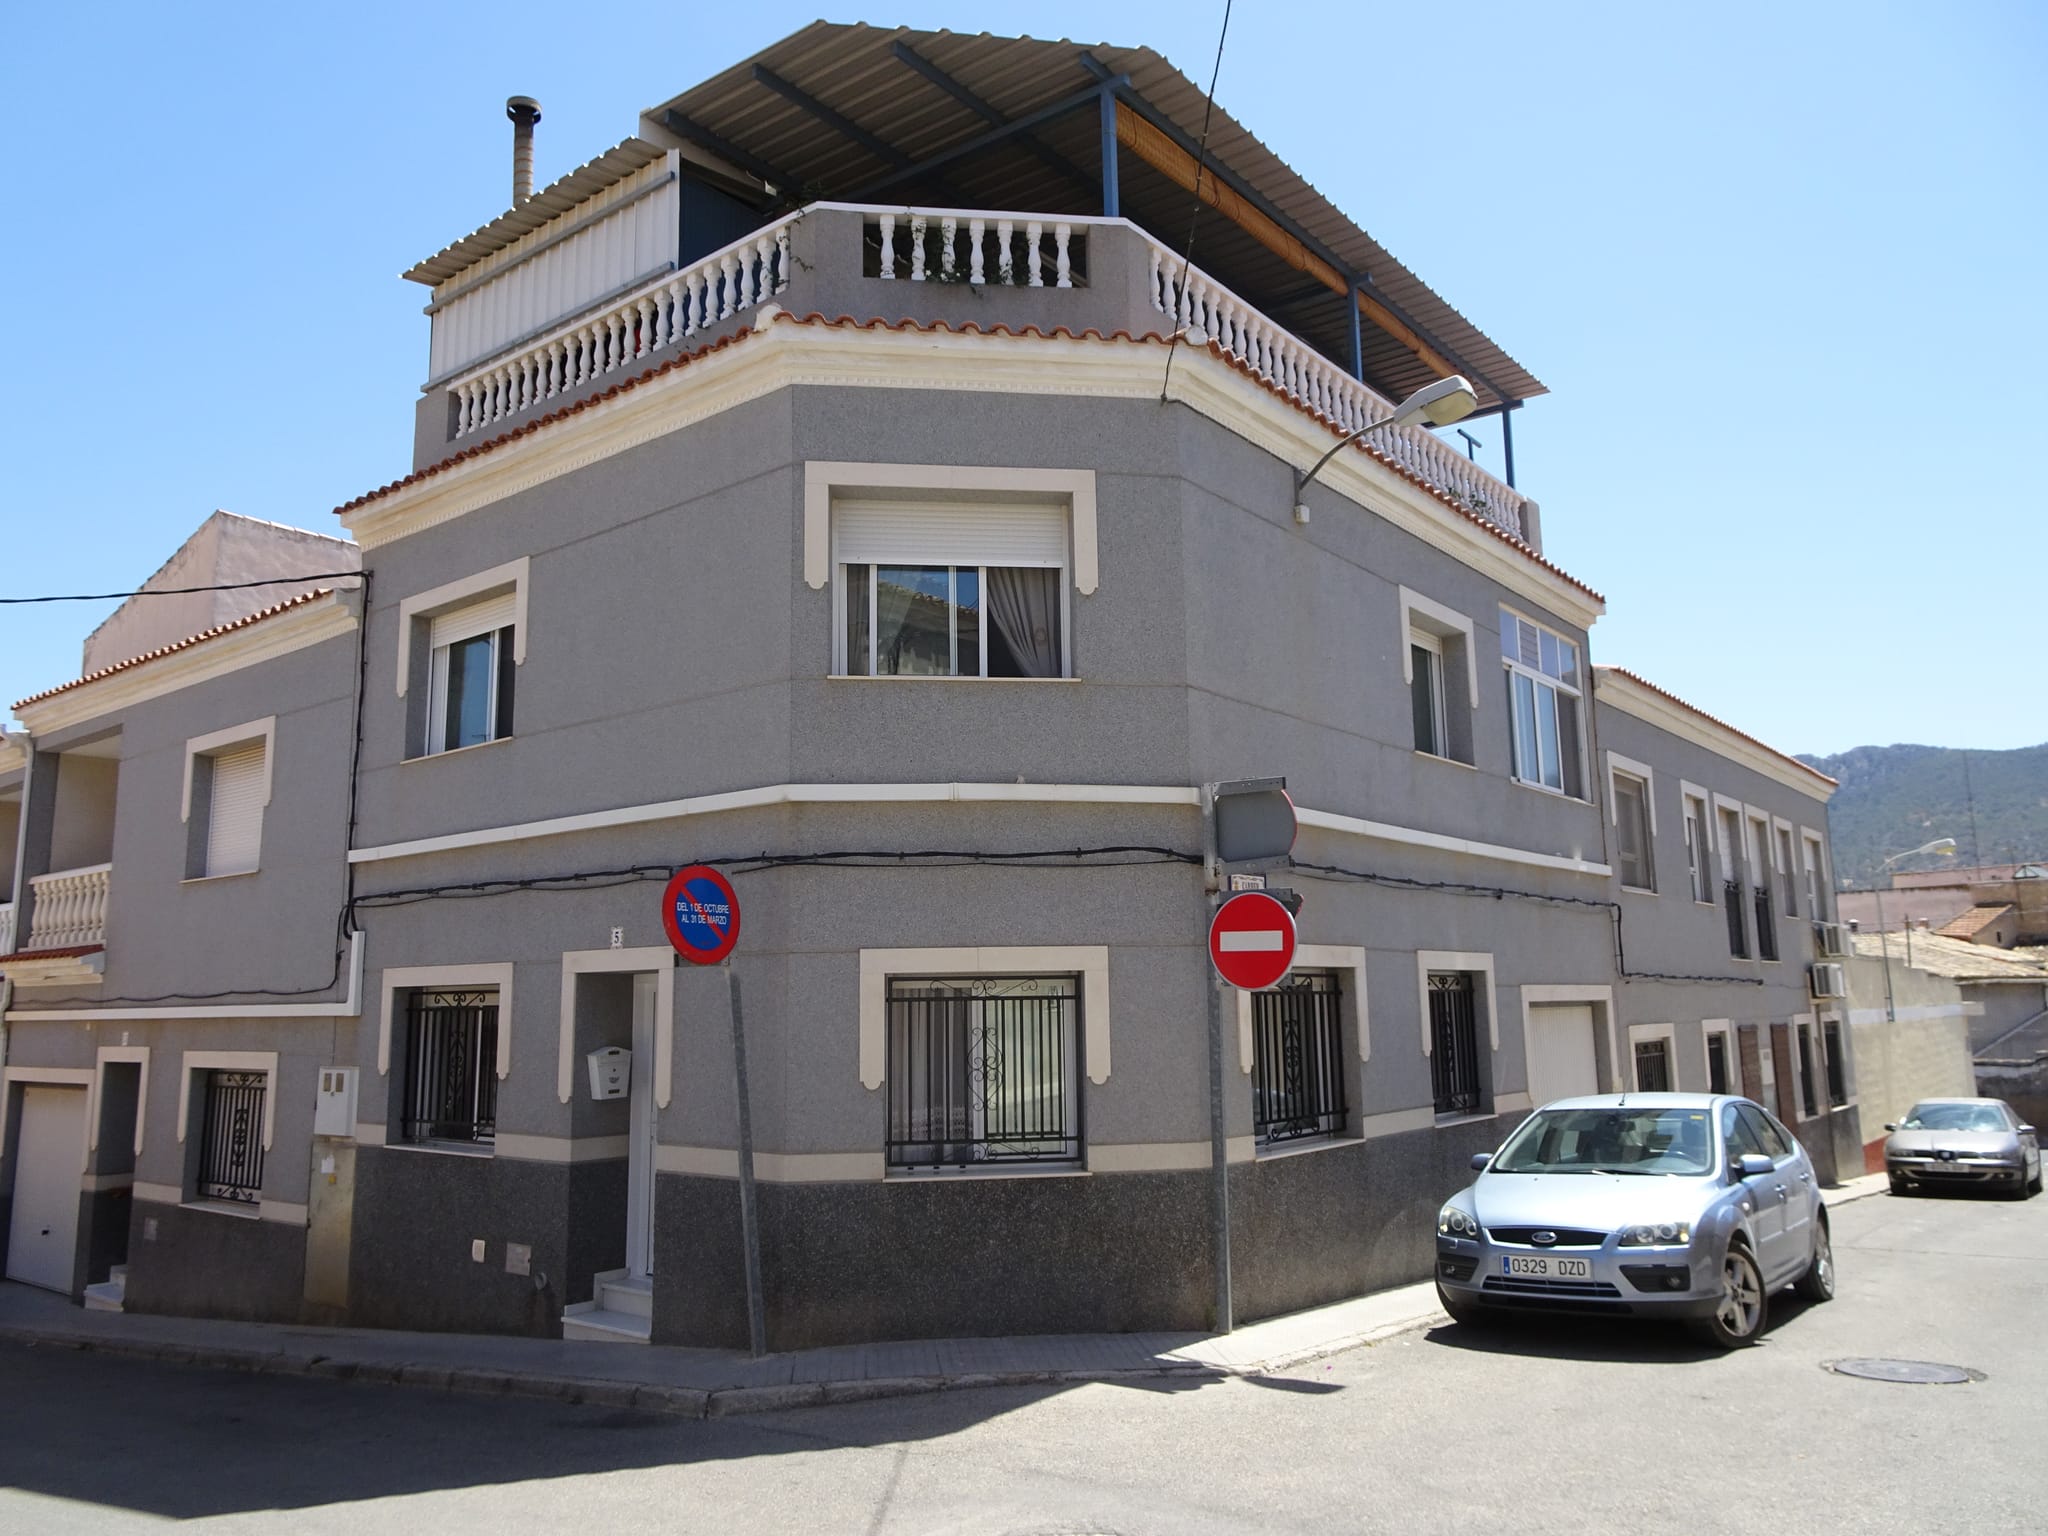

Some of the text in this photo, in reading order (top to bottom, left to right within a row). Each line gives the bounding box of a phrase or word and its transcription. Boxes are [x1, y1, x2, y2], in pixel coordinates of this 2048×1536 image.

[676, 902, 689, 912] DEL
[694, 903, 703, 912] DE
[703, 903, 729, 914] OCTUBRE
[681, 914, 727, 925] AL 31 DE MARZO
[614, 931, 620, 944] 5
[1512, 1258, 1586, 1276] 0329 DZD
